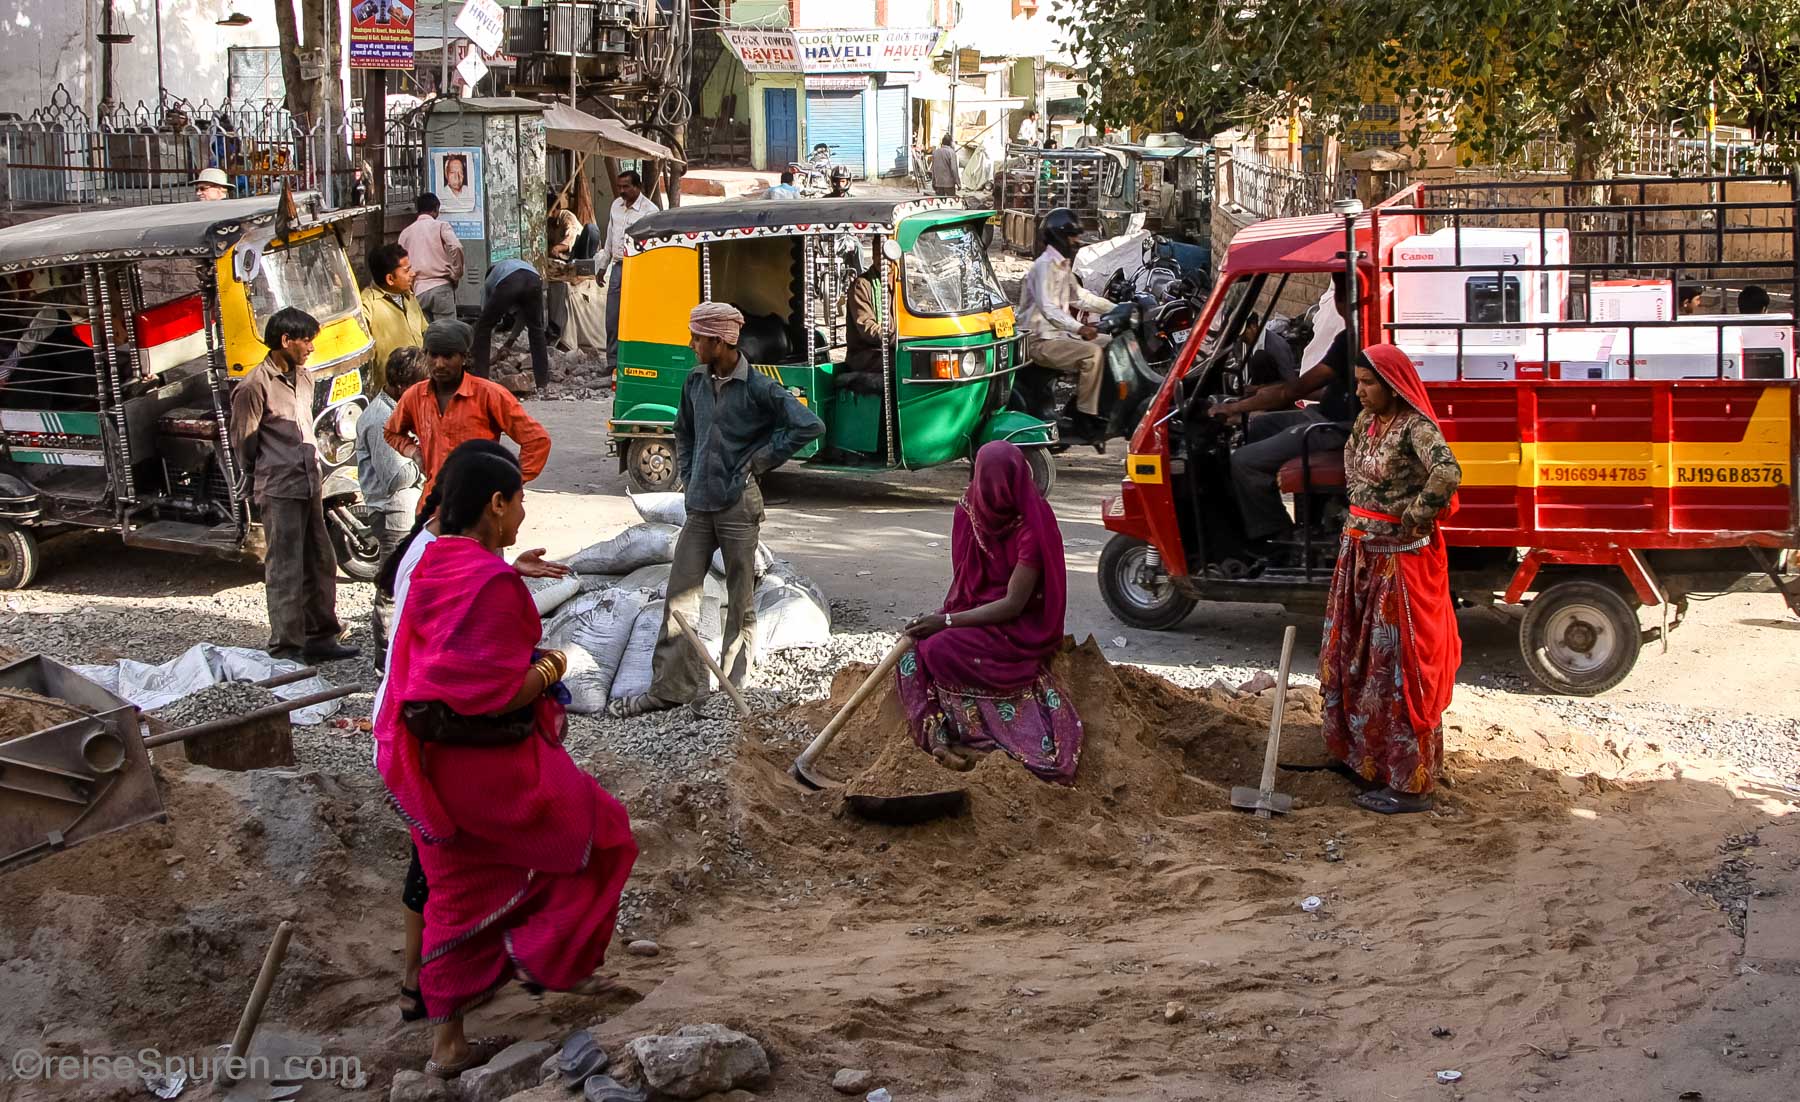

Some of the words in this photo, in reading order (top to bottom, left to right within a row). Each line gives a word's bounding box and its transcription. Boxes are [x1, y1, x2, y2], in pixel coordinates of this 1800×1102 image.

[763, 36, 793, 46] TOWER
[798, 35, 833, 45] CLOCK
[839, 33, 880, 43] TOWER
[740, 47, 794, 61] HAVELI
[805, 45, 872, 59] HAVELI
[884, 45, 929, 57] HAVELI
[1400, 252, 1434, 262] Canon
[1656, 297, 1664, 321] Cano
[1616, 358, 1647, 366] Caon
[1540, 467, 1647, 482] M.9166944785
